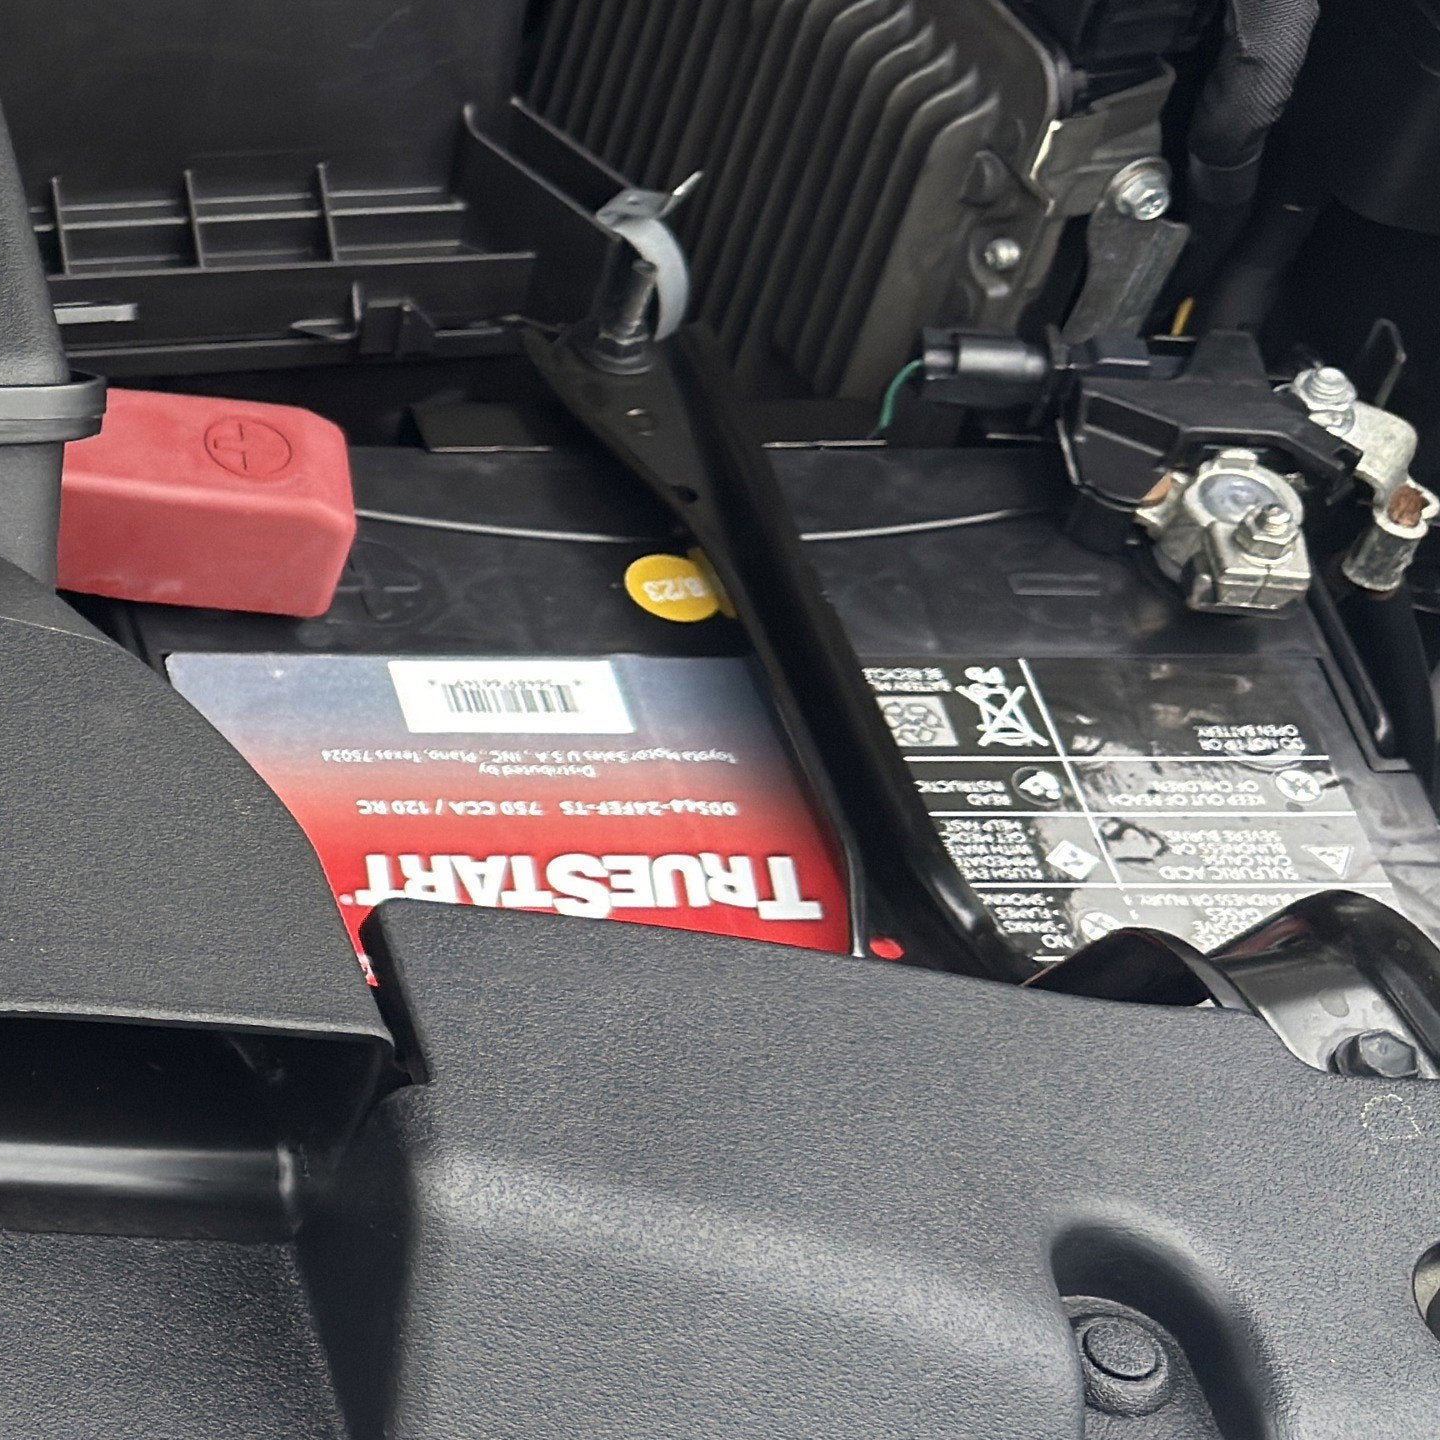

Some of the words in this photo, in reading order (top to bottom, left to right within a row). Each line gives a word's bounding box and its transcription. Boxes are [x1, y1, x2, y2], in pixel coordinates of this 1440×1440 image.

[478, 762, 492, 778] by
[495, 764, 597, 779] Distributed
[356, 799, 389, 815] RC
[392, 799, 431, 816] 120
[450, 799, 497, 816] CCA
[500, 799, 543, 816] 750
[1164, 794, 1185, 806] OF
[1188, 794, 1224, 806] OUT
[1158, 866, 1204, 879] ACID
[1207, 866, 1298, 880] SULFURIC
[355, 851, 824, 922] TRUESTART
[1041, 933, 1073, 948] NO
